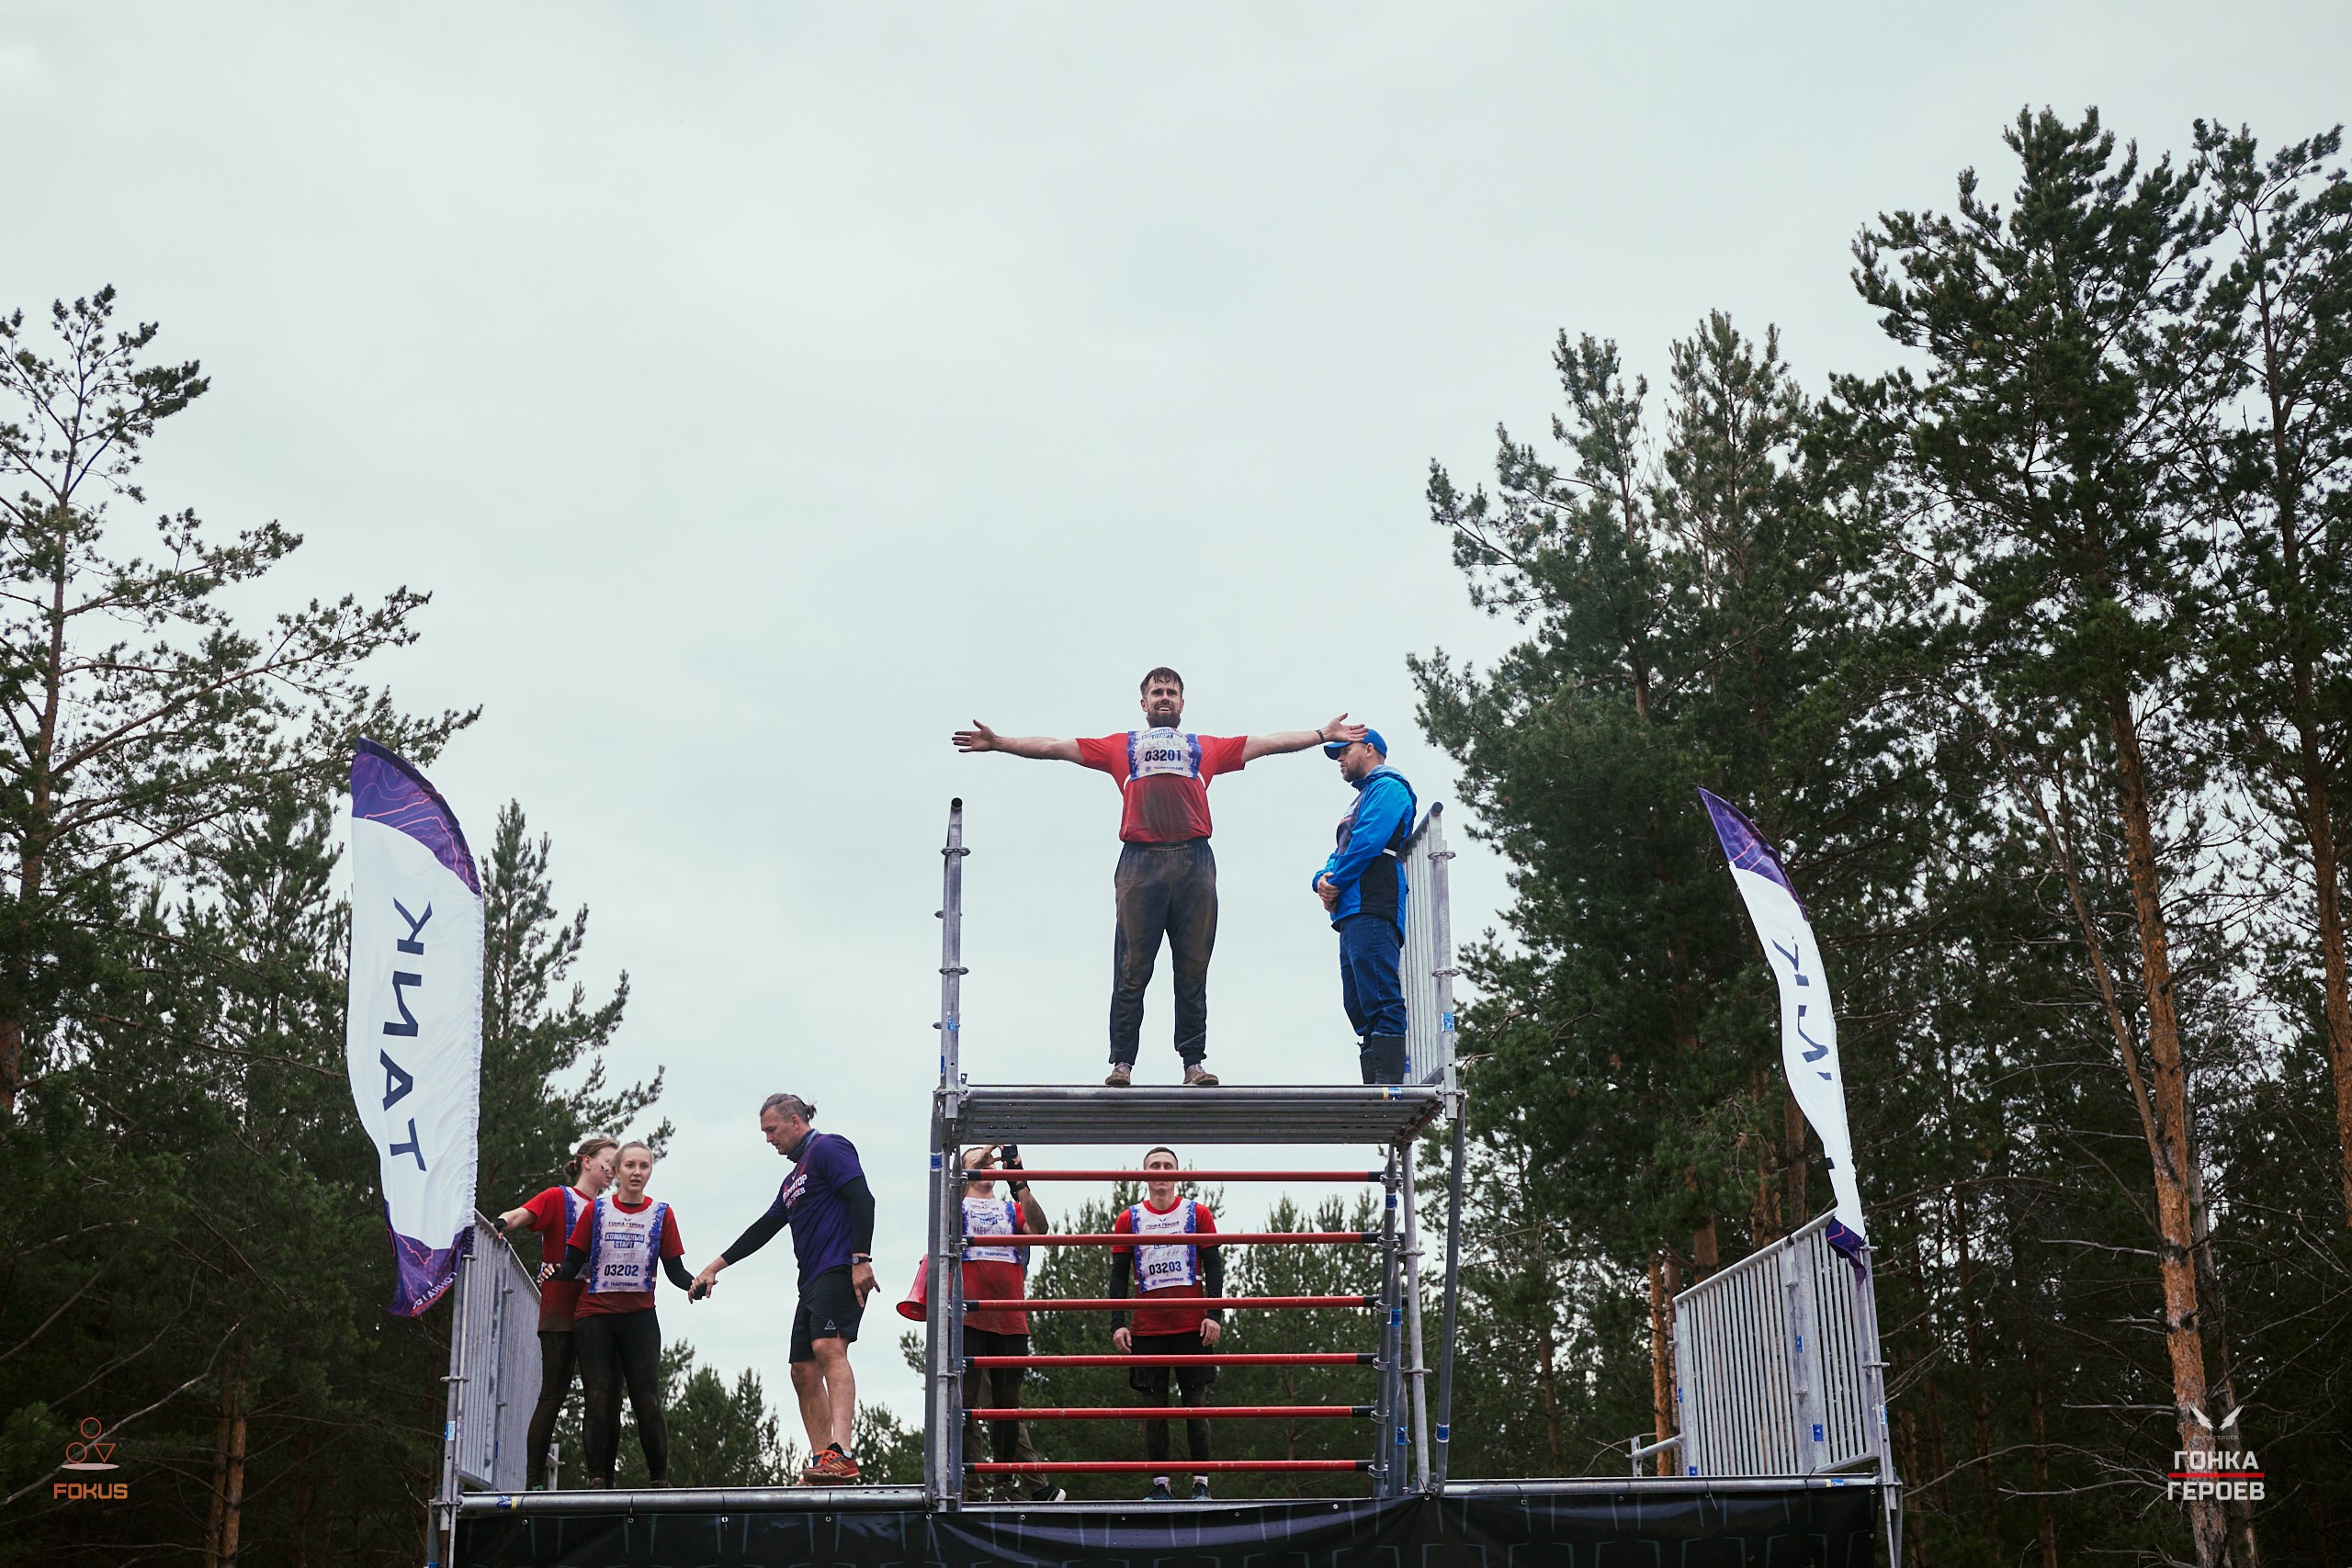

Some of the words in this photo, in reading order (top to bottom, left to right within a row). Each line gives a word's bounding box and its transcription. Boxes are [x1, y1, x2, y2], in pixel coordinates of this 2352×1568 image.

[1145, 749, 1182, 761] 03201
[604, 1264, 639, 1277] 03202
[1148, 1260, 1182, 1276] 03203
